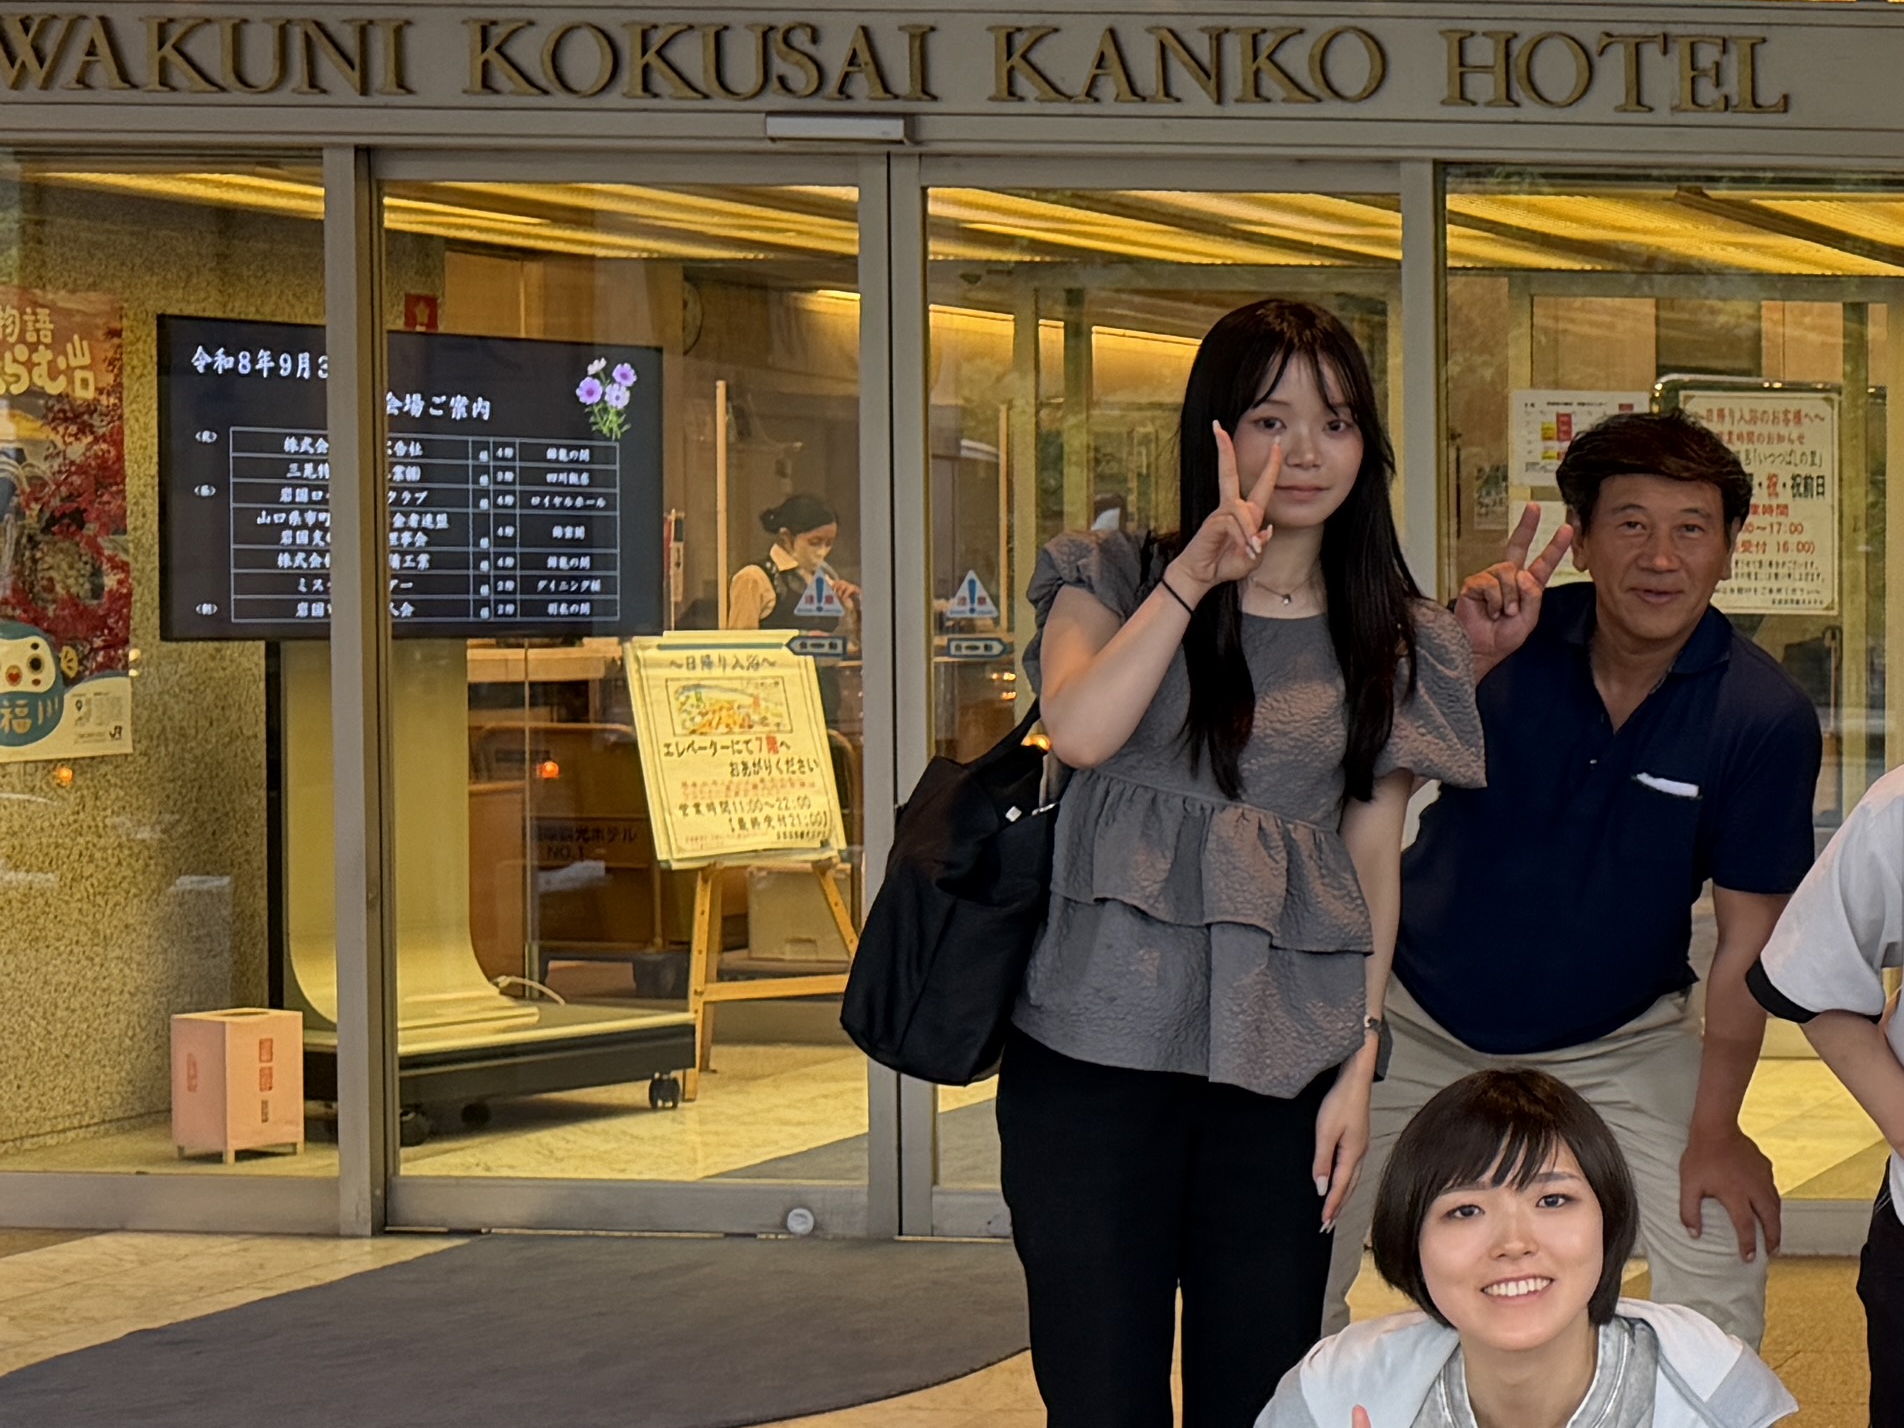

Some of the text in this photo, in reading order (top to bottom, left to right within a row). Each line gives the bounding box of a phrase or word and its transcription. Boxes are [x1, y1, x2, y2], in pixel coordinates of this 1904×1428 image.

[0, 12, 1790, 114] WAKUNI KOKUSAI KANKO HOTEL
